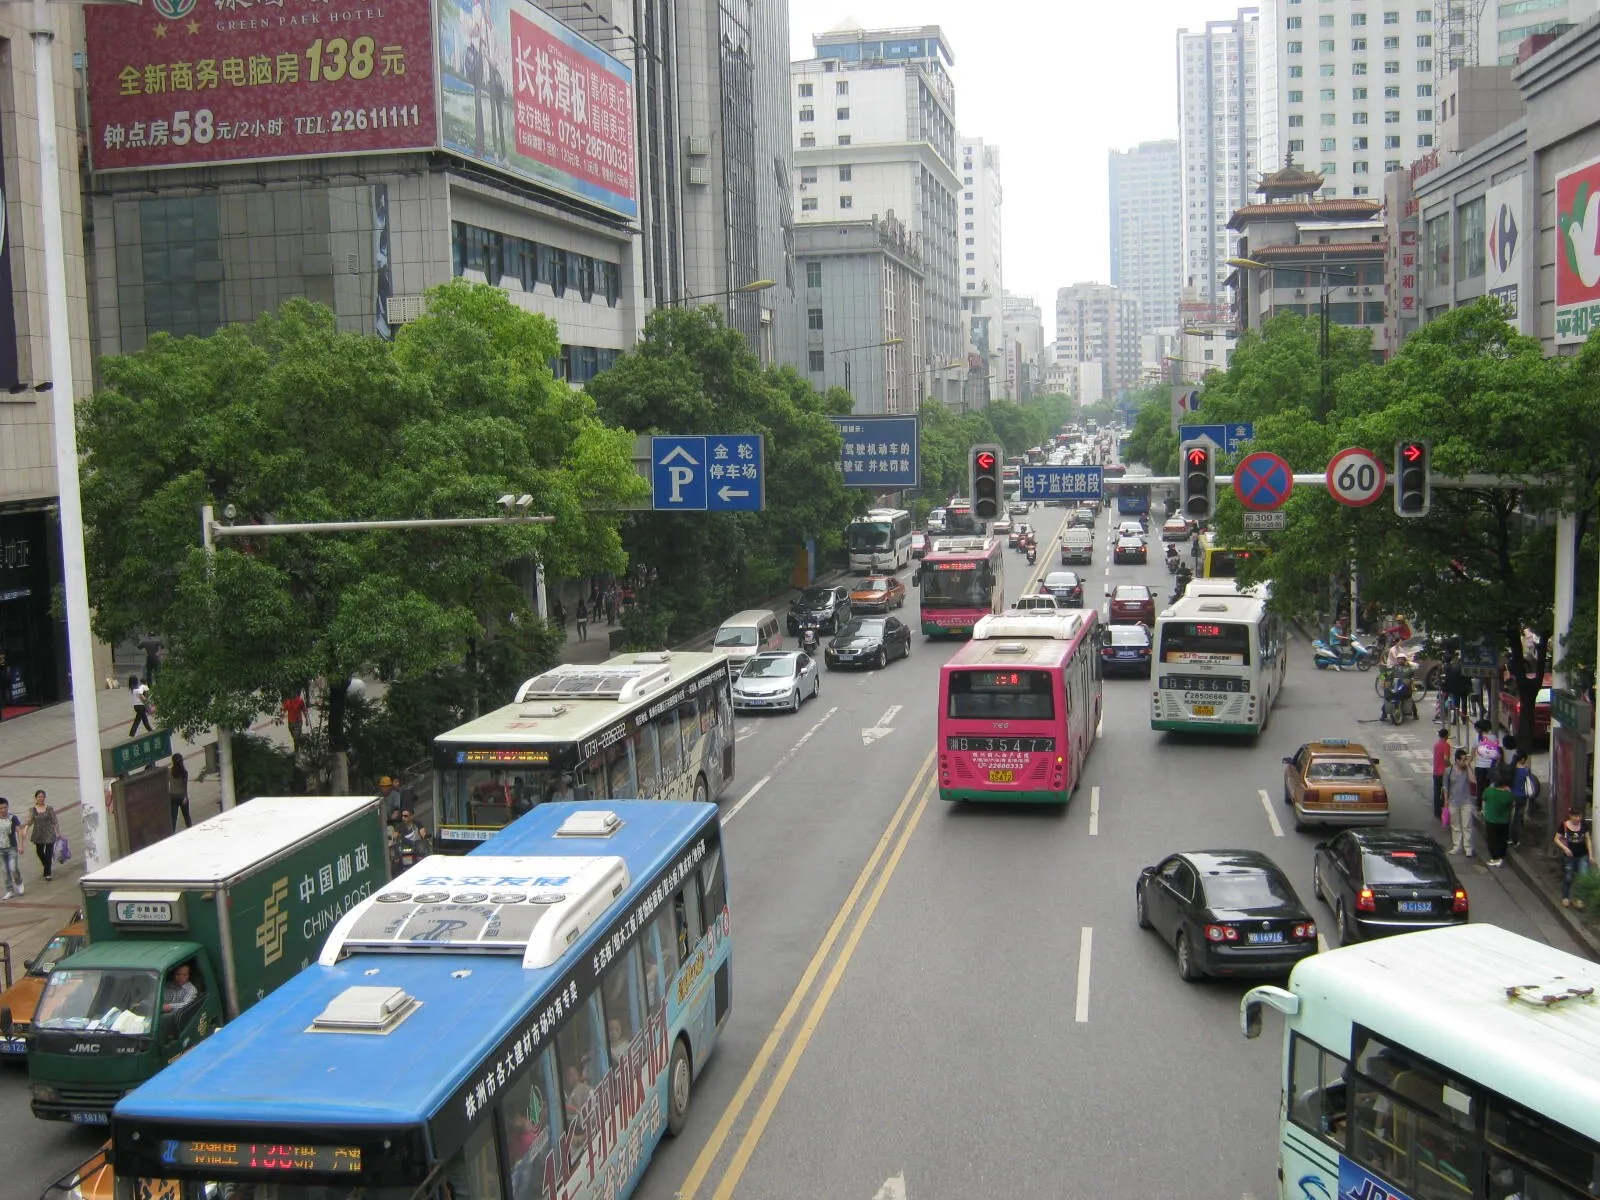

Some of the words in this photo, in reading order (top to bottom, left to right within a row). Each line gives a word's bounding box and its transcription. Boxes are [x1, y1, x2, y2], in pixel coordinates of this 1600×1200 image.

[216, 18, 270, 32] GREEN
[279, 13, 321, 27] PARK
[330, 7, 386, 22] HOTEL
[515, 36, 588, 125] 长株潭报
[294, 104, 421, 136] TEL:22611111
[558, 118, 628, 173] 0731-28670033
[1402, 253, 1416, 310] 平和堂
[840, 443, 910, 456] 驾驶机动车的
[709, 464, 758, 480] 停车场
[868, 460, 910, 473] 并处罚款
[1336, 463, 1375, 492] 60
[668, 466, 694, 502] P
[1023, 473, 1100, 493] 电子监控路段
[299, 842, 370, 905] 中国邮政
[303, 904, 343, 940] CHINA
[343, 881, 373, 914] POST
[69, 1043, 101, 1053] JMC
